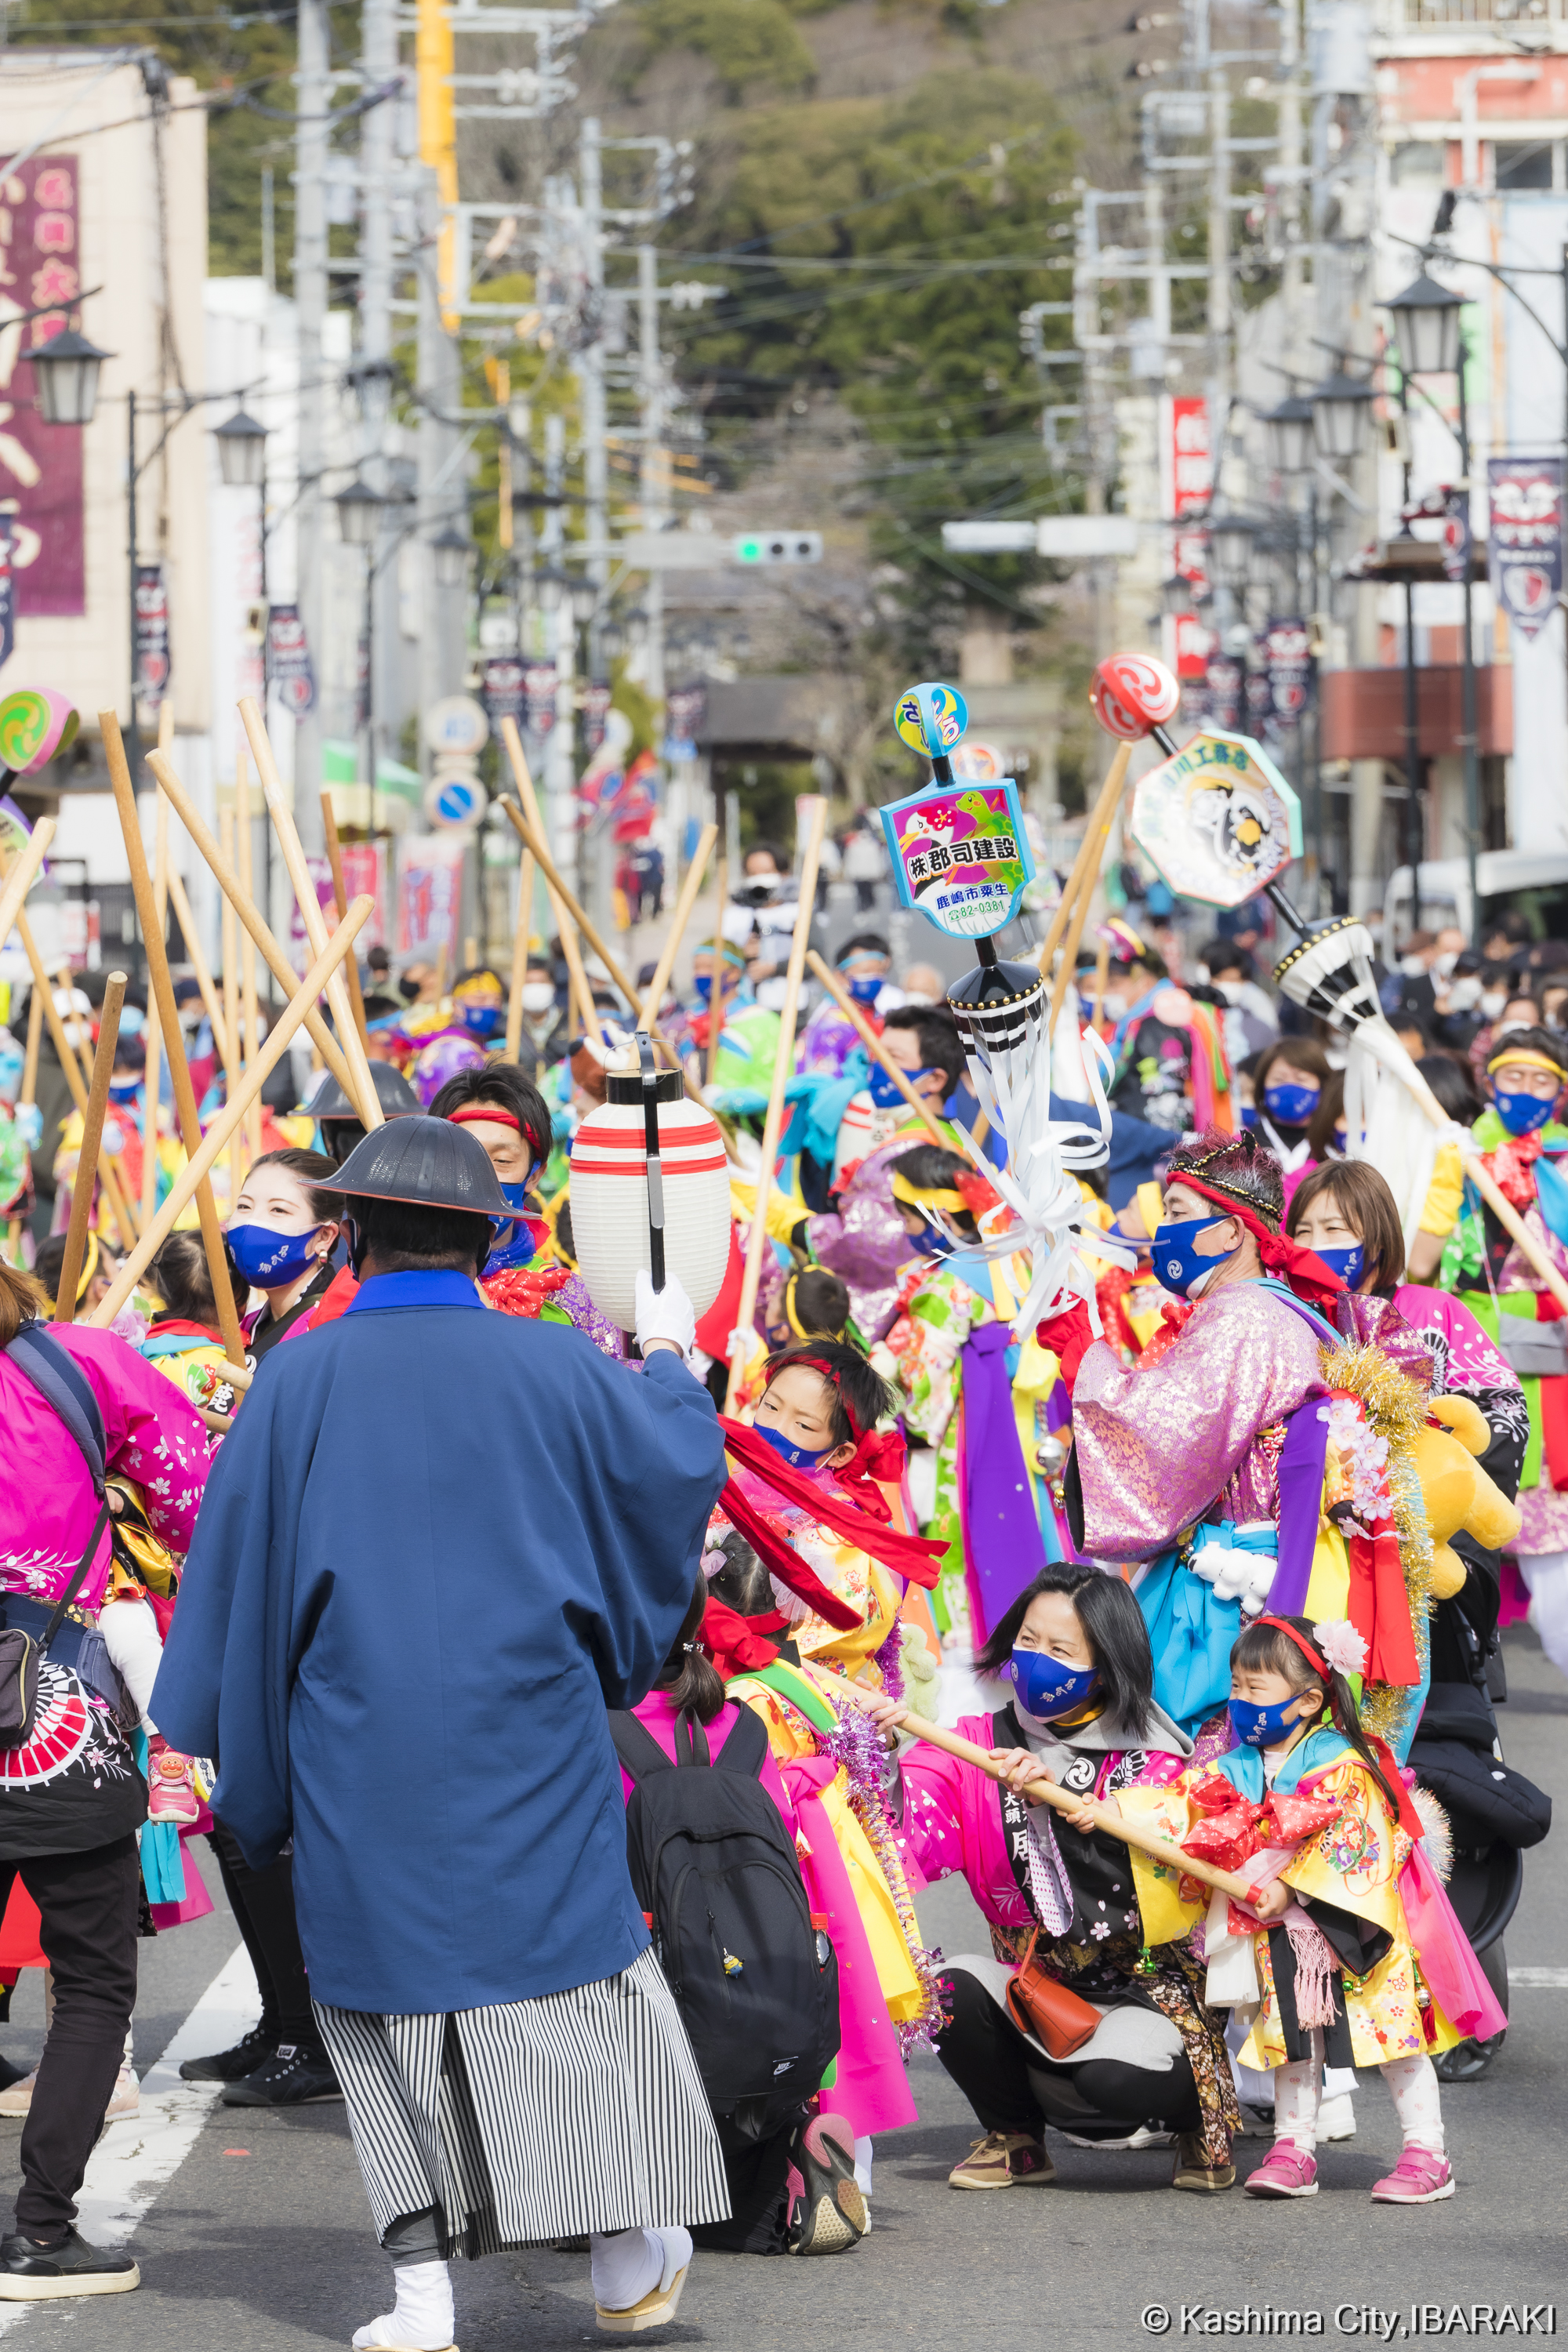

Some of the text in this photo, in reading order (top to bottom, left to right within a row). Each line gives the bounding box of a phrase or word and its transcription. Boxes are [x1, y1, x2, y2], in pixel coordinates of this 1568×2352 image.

[908, 837, 1018, 881] (株)郡司建設
[936, 882, 1009, 910] 鹿嶋市粟生
[960, 898, 1004, 918] 82-0381
